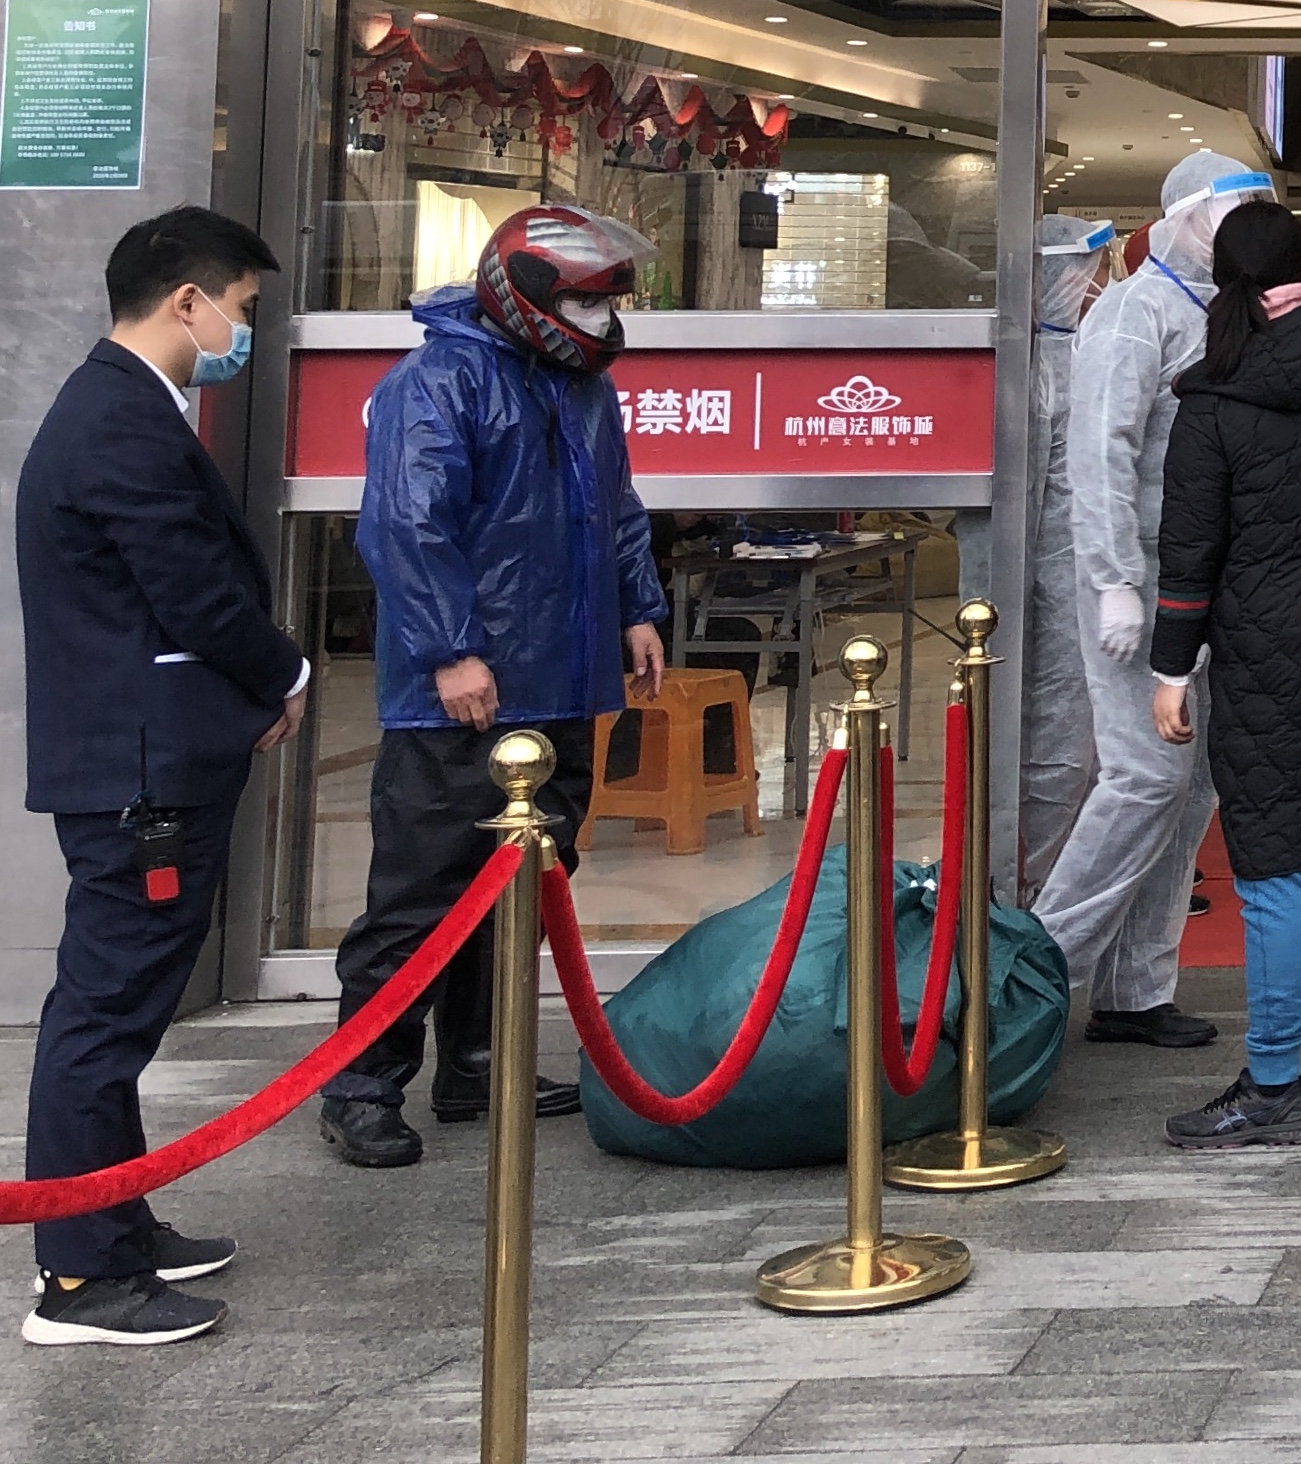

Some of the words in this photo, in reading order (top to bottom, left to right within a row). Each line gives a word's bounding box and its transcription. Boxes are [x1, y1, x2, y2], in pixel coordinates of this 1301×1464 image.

[784, 416, 934, 436] 杭州意法服饰城
